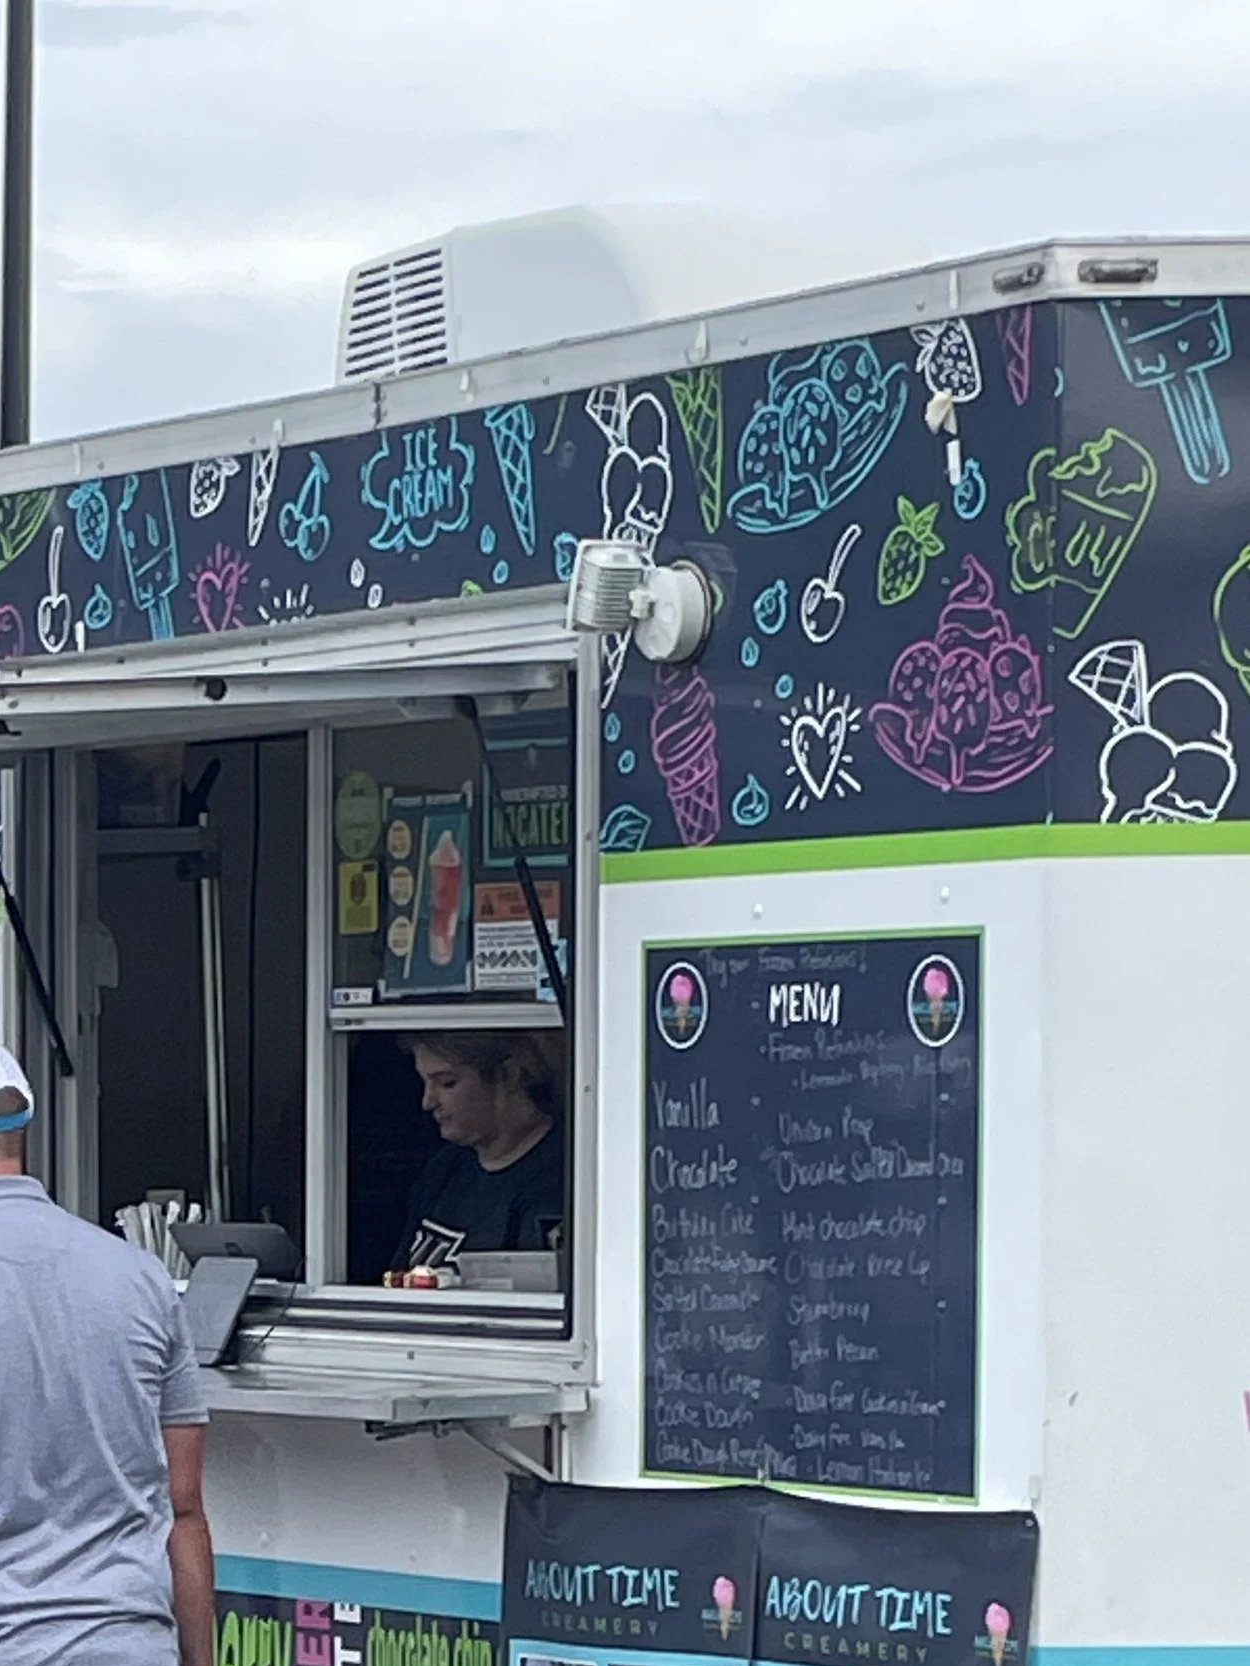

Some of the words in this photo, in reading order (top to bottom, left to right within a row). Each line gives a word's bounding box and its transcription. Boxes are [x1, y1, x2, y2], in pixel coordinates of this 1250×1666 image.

[402, 427, 438, 472] ICE
[388, 465, 454, 526] CREAM
[768, 981, 841, 1028] MENU
[524, 1558, 603, 1608] ABOUT
[605, 1564, 682, 1613] TIME
[764, 1574, 871, 1632] ABOUT
[874, 1585, 953, 1640] TIME
[541, 1609, 661, 1639] CREAMERY
[784, 1631, 929, 1665] CREAMERY
